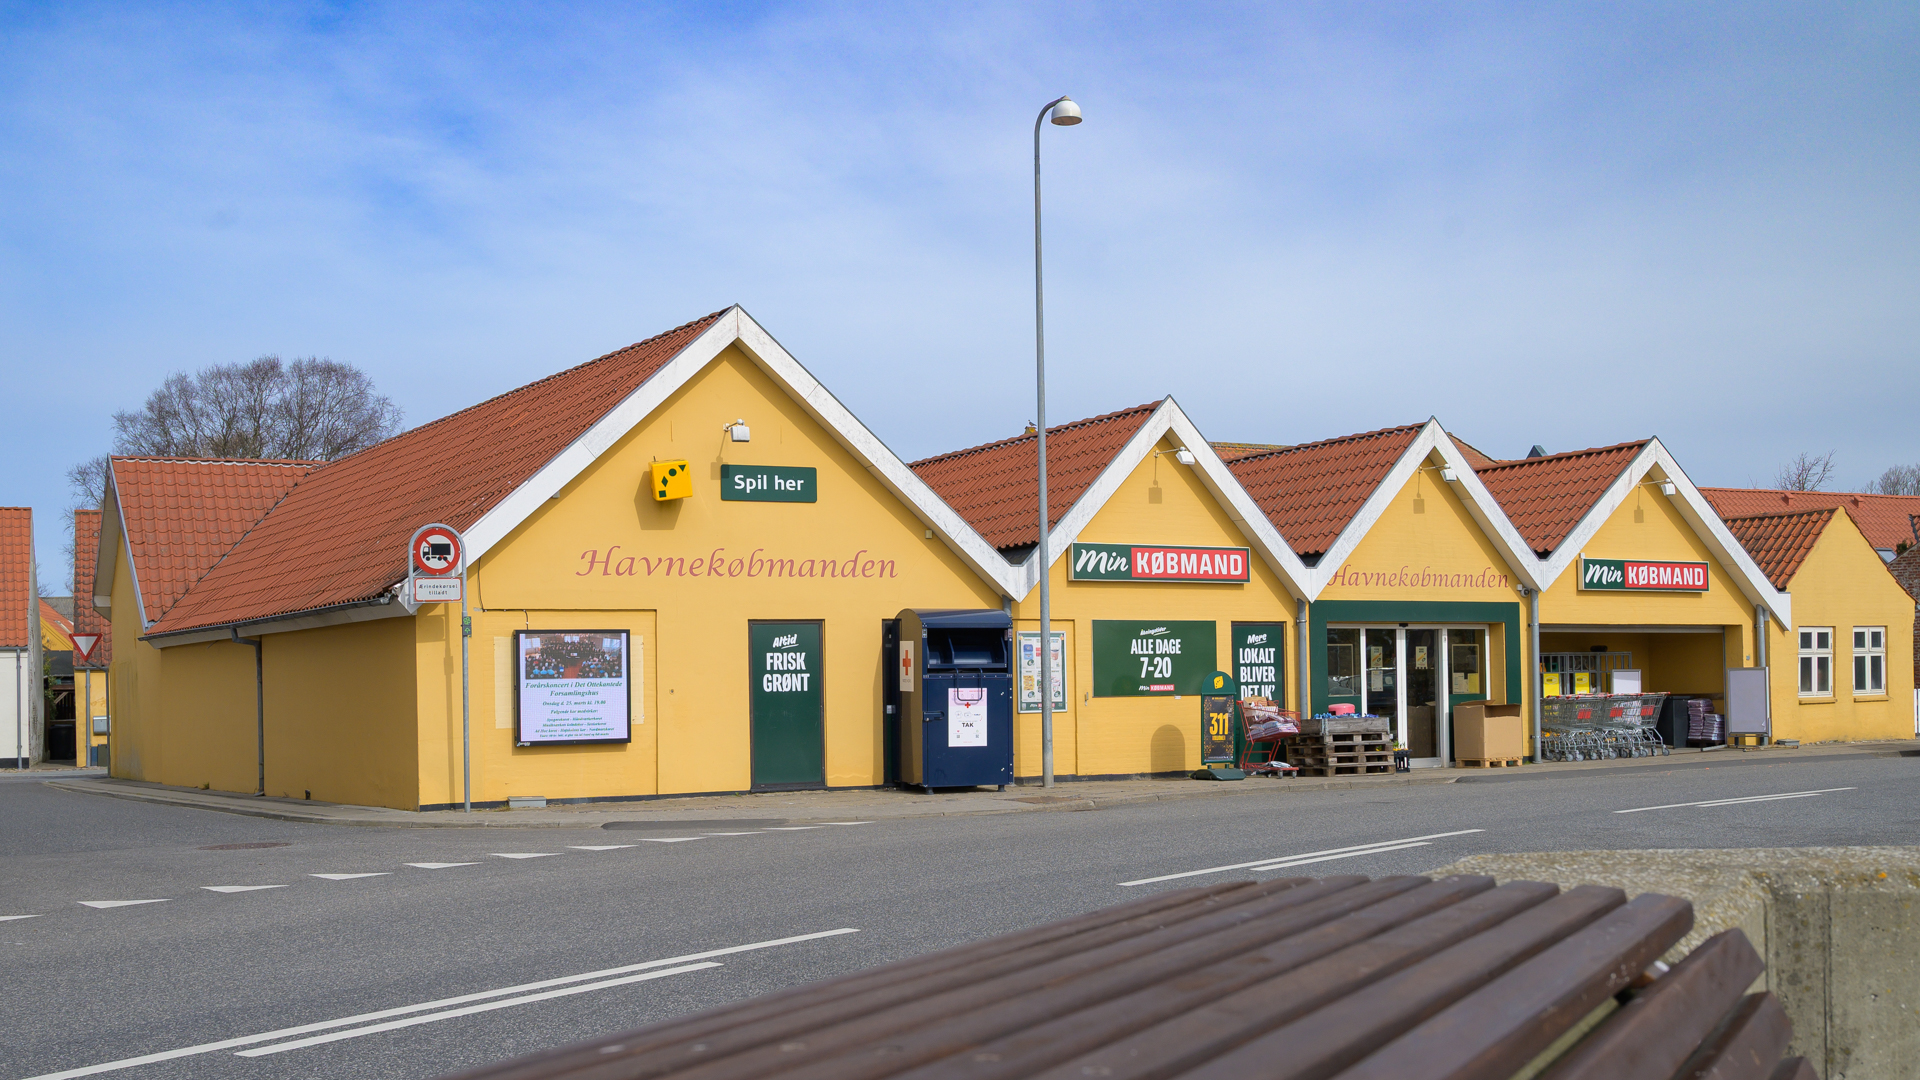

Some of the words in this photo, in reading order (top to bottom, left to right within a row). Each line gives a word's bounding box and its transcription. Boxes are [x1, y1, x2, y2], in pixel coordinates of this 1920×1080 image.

[734, 474, 768, 494] Spil
[774, 474, 805, 491] her
[575, 545, 899, 579] Havnekøbmanden
[1075, 549, 1129, 574] Min
[1136, 551, 1243, 576] KØBMAND
[1327, 564, 1510, 588] Havnekøbmanden
[1585, 563, 1623, 585] Min
[1628, 565, 1704, 586] KØBMAND
[772, 633, 798, 649] Altid
[1130, 638, 1154, 655] ALLE
[1155, 638, 1182, 655] DAGE
[1247, 633, 1268, 645] Mere
[766, 652, 807, 671] FRISK
[1239, 647, 1276, 664] LOKALT
[1140, 656, 1172, 679] 7-20
[1240, 665, 1276, 683] BLIVER
[762, 672, 811, 693] GRØNT
[549, 689, 599, 697] Forsamlingshus
[1209, 712, 1229, 735] 311
